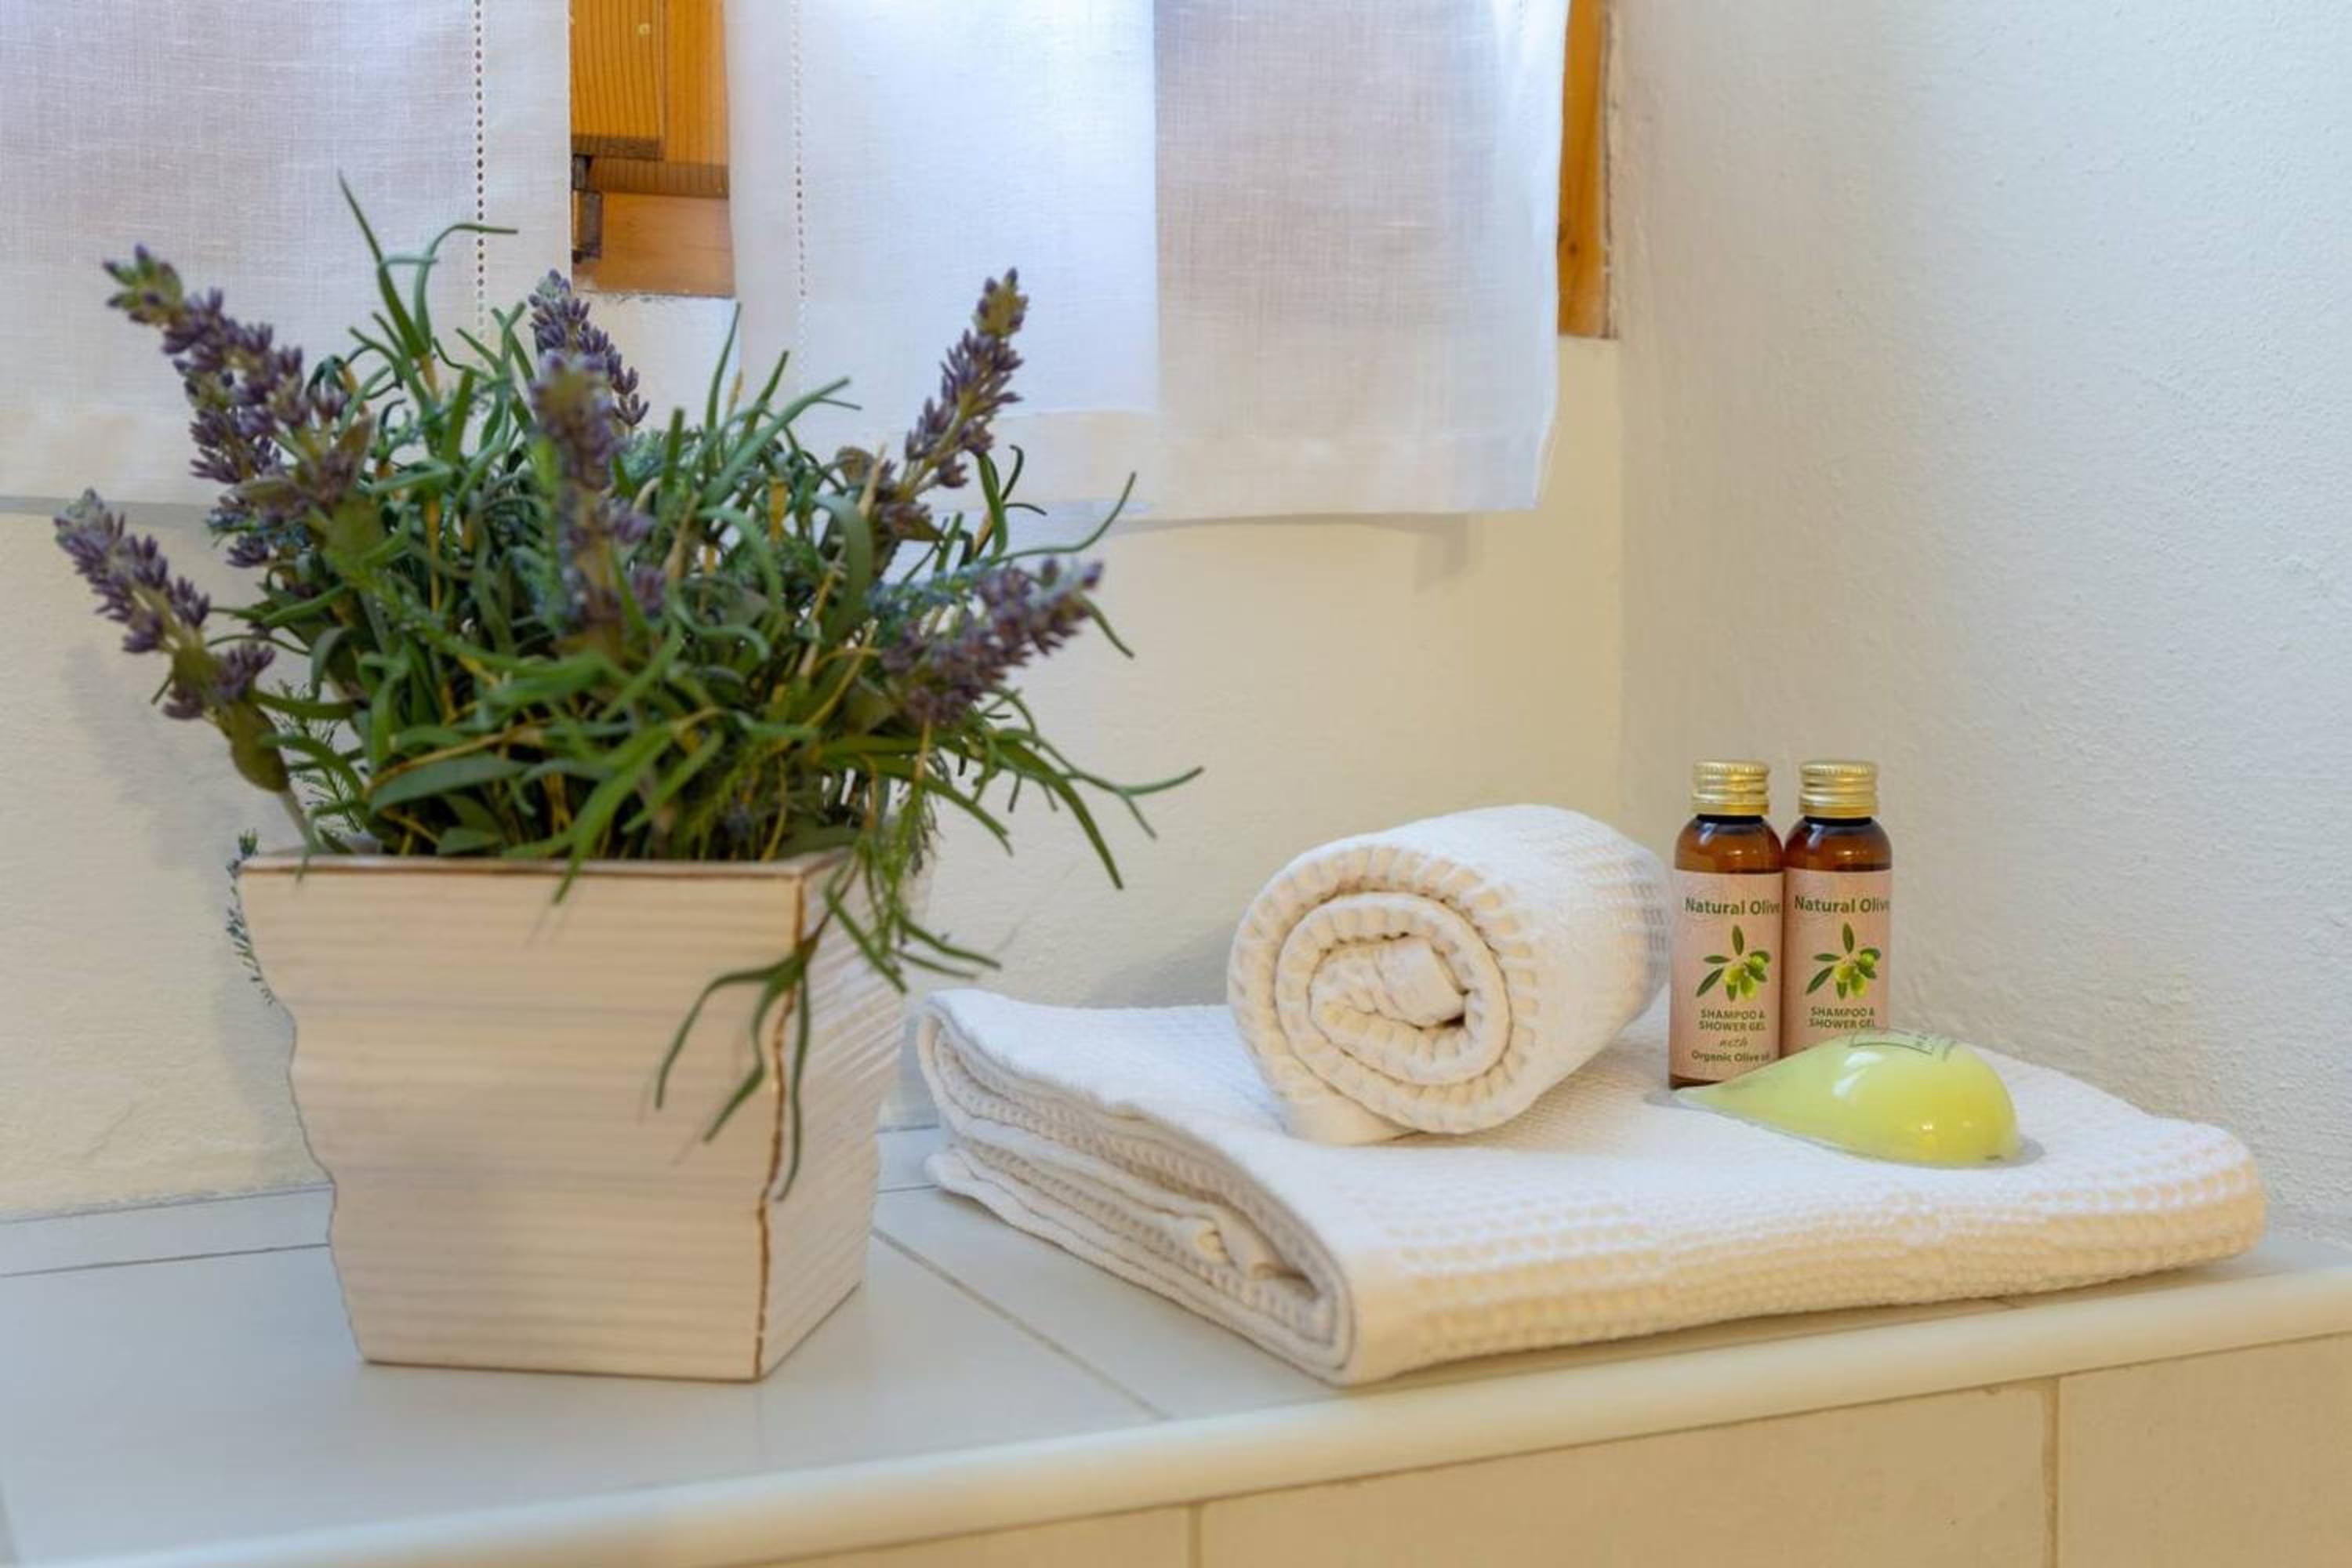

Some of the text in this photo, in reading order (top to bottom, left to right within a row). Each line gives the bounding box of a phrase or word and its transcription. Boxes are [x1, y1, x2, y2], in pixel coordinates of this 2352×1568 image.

[1684, 896, 1746, 916] Natural
[1794, 895, 1856, 913] Natural
[1700, 1008, 1756, 1020] SHAMPOO
[1810, 1006, 1867, 1018] SHAMPOO
[1698, 1020, 1767, 1032] SHOWER GEL
[1808, 1017, 1857, 1029] SHOWER
[1691, 1050, 1732, 1062] Organic
